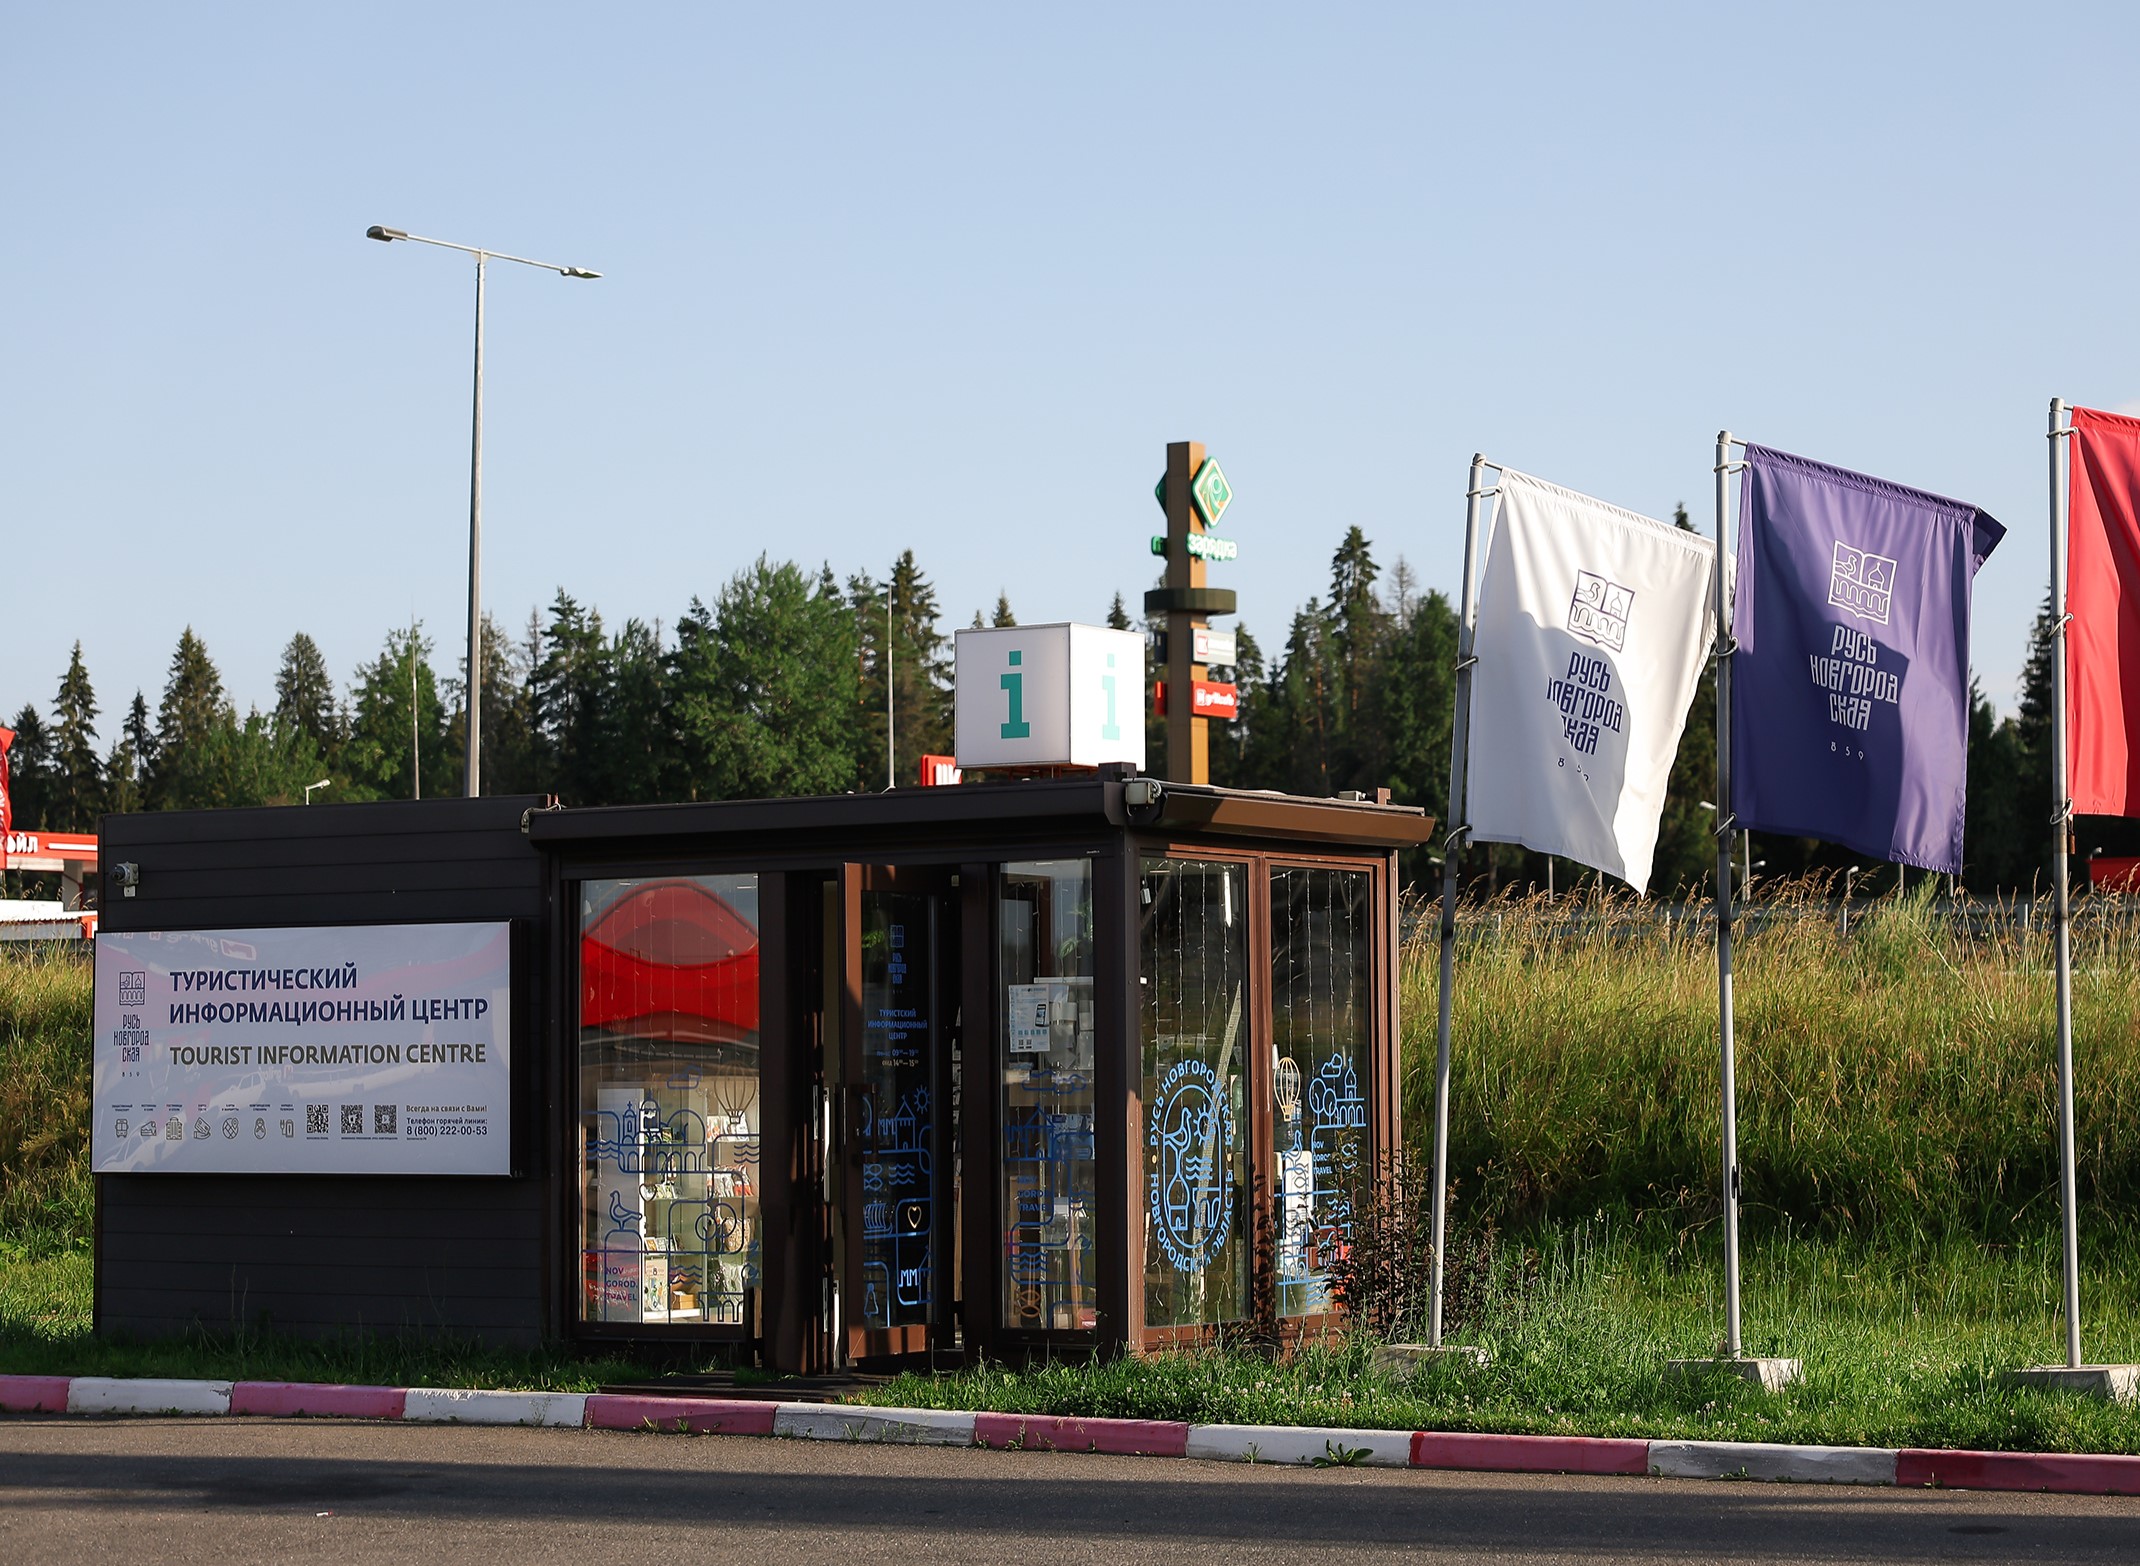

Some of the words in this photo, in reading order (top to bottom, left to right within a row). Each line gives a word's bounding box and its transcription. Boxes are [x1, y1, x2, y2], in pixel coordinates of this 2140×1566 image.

[1831, 625, 1877, 665] РУСЬ
[1567, 651, 1611, 692] РУСЬ
[1810, 654, 1898, 704] НОВГОРОД
[1000, 650, 1030, 739] i
[1829, 693, 1872, 730] СКАЯ
[169, 961, 357, 991] ТУРИСТИЧЕСКИЙ
[122, 1014, 141, 1029] РУСЬ
[169, 994, 405, 1026] ИНФОРМАЦИОННЫЙ
[412, 998, 488, 1024] ЦЕНТР
[113, 1030, 150, 1046] НОВГОРОД
[122, 1047, 140, 1062] СКАЯ
[169, 1046, 252, 1065] TOURIST
[257, 1044, 400, 1065] INFORMATION
[406, 1043, 487, 1063] CENTRE
[406, 1105, 429, 1113] Всегда
[467, 1105, 488, 1113] Вами!
[406, 1117, 435, 1126] Телефон
[435, 1116, 464, 1126] горячей
[465, 1117, 488, 1125] линии:
[1150, 1096, 1165, 1146] РУСЬ
[406, 1126, 412, 1135] 8
[414, 1125, 438, 1137] (800)
[440, 1125, 488, 1136] 222-00-53
[605, 1266, 624, 1275] NOV
